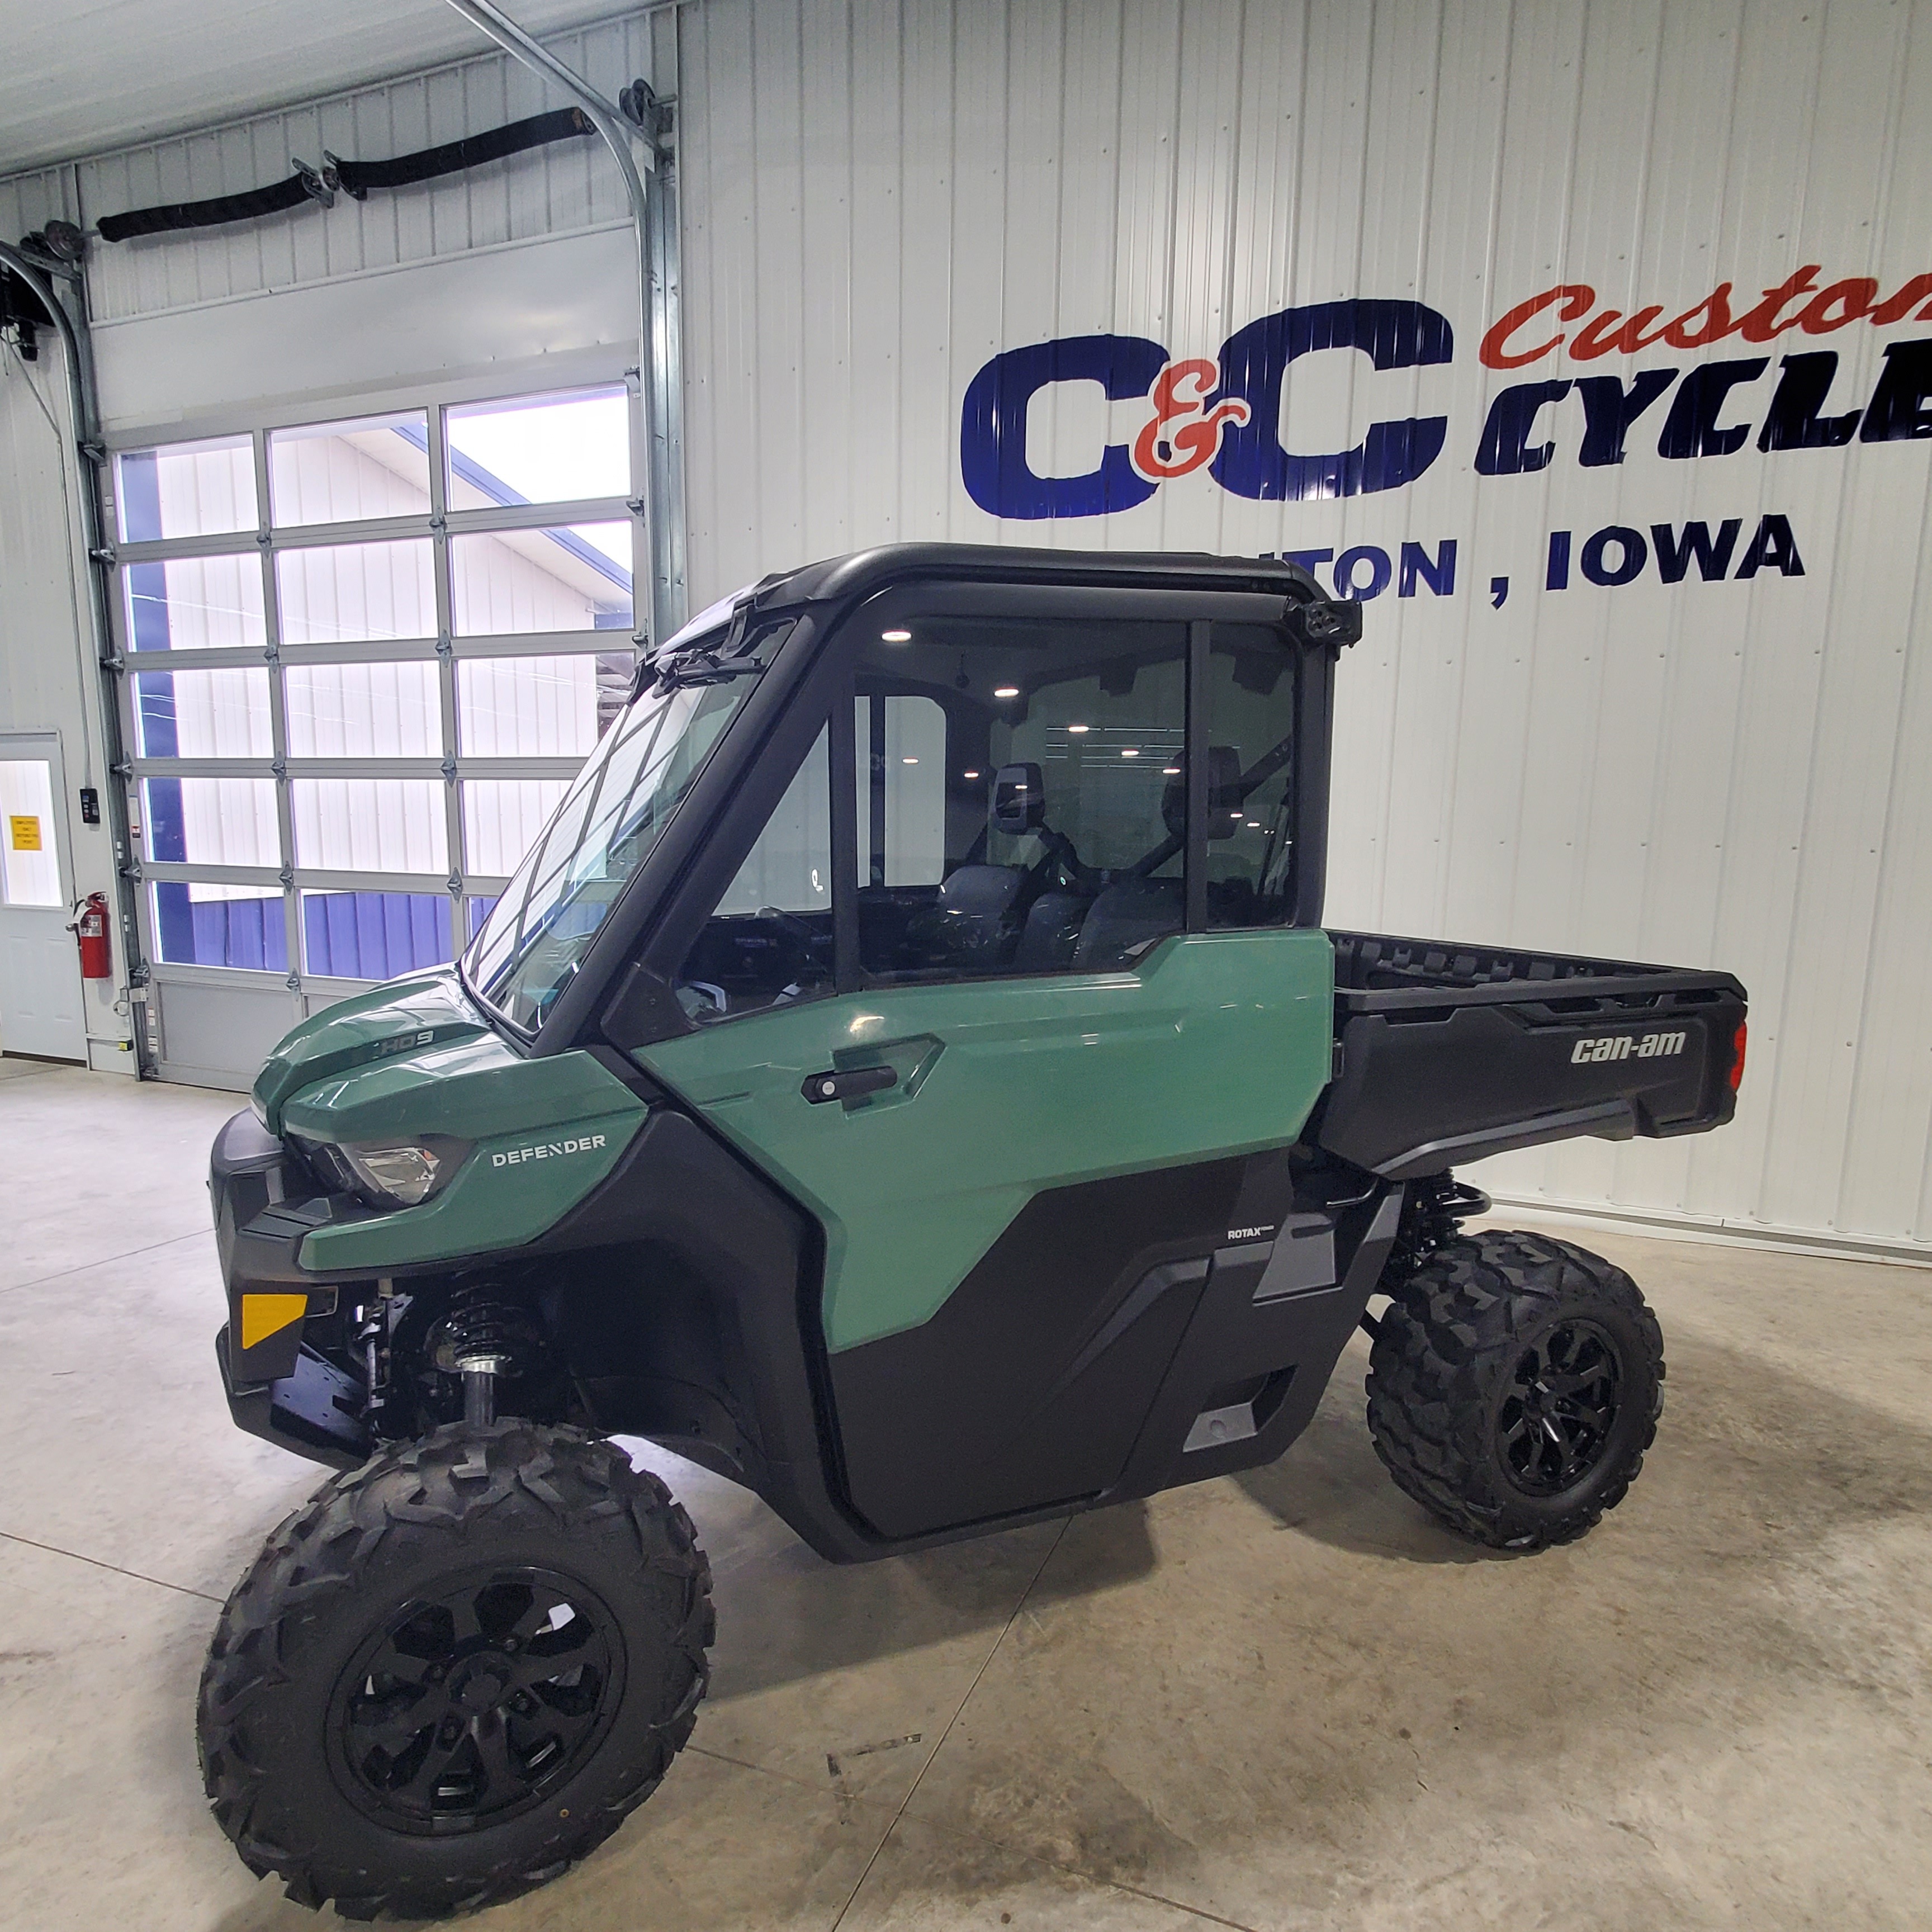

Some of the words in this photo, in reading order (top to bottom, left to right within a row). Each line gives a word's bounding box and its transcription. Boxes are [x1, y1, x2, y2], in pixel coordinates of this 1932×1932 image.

[960, 298, 1453, 520] C&C
[1259, 539, 1457, 601] TON
[1545, 514, 1806, 591] IOWA
[1570, 1031, 1686, 1064] can-am
[491, 1135, 606, 1167] DEFENDER
[1228, 1227, 1261, 1240] ROTAX
